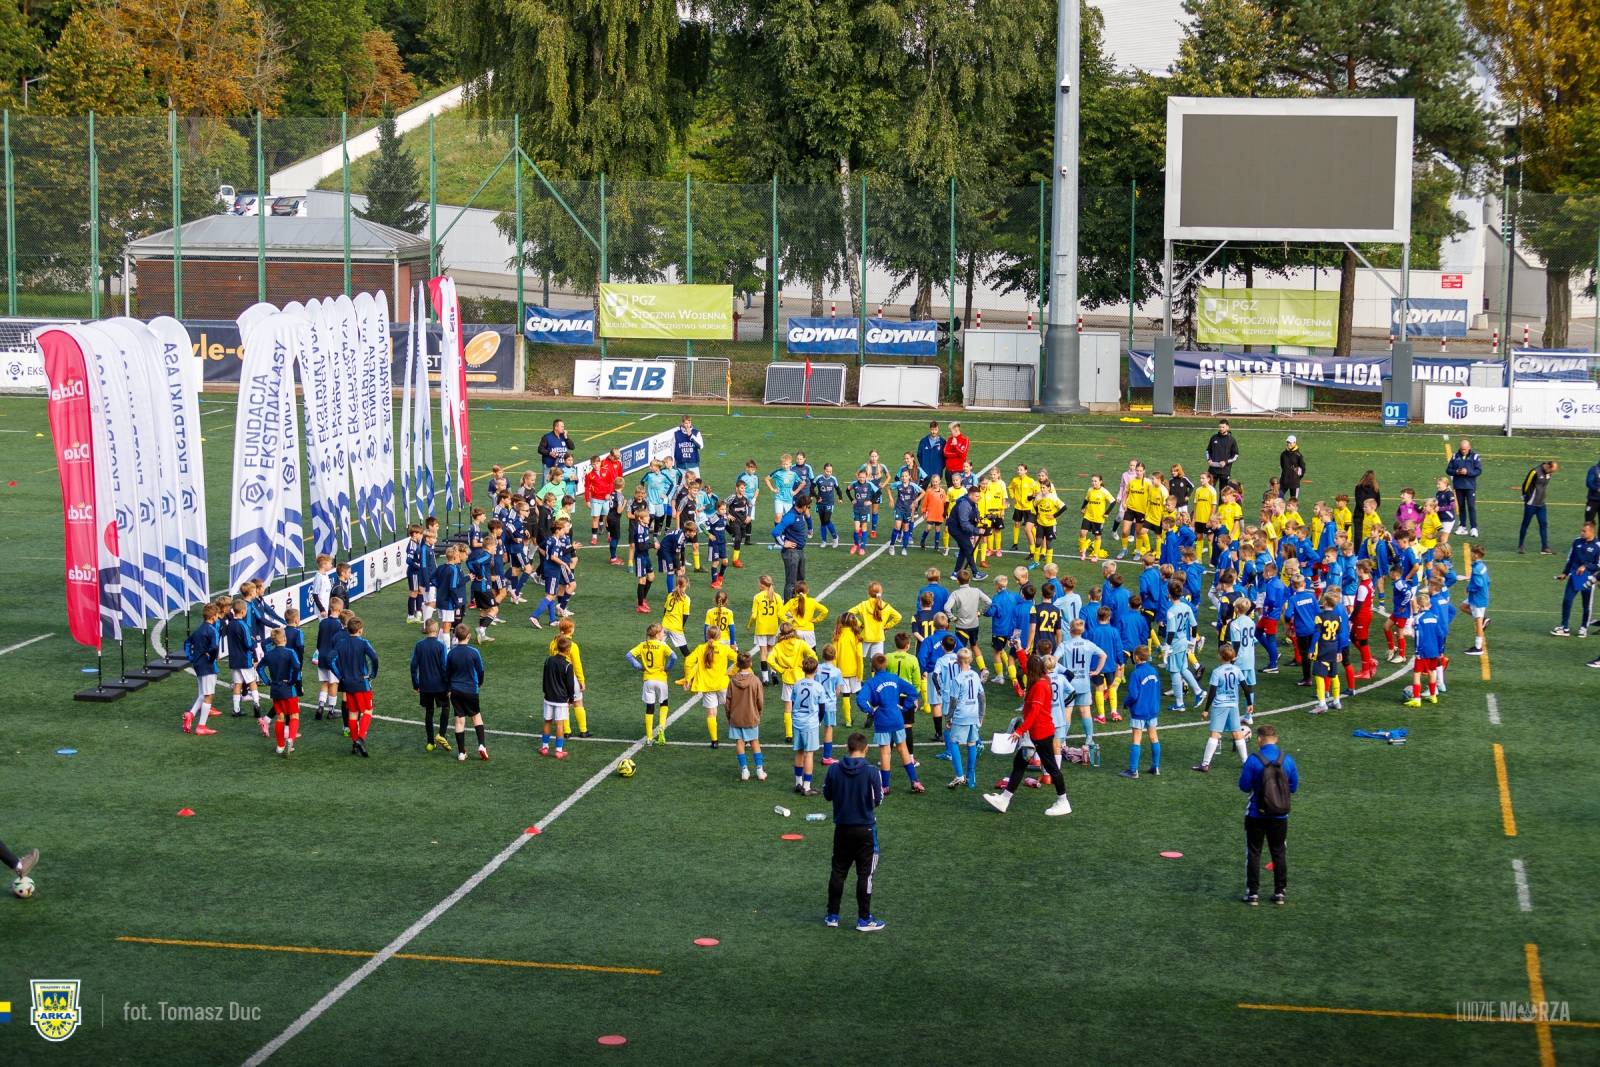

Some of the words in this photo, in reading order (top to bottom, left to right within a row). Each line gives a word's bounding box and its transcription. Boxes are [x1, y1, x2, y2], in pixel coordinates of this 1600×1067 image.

[631, 295, 656, 306] PGZ
[1232, 300, 1258, 311] PGZ
[631, 308, 677, 320] STOCZNIA
[678, 309, 727, 320] WOJENNA
[1231, 313, 1279, 326] STOCZNIA
[1281, 314, 1333, 328] WOJENNA
[1393, 308, 1466, 325] GDYNIA
[526, 316, 593, 333] GDYNIA
[605, 321, 638, 330] BUDUJEMY
[698, 322, 727, 331] MORSKIE
[788, 327, 858, 343] GDYNIA
[866, 327, 936, 344] GDYNIA
[1302, 330, 1332, 338] MORSKIE
[1513, 357, 1588, 374] GDYNIA
[608, 366, 667, 391] EIB
[1334, 363, 1382, 387] LIGA
[259, 339, 288, 470] EKSTRAKLASY
[1385, 405, 1400, 418] 01
[1474, 404, 1496, 413] Bank
[1498, 404, 1522, 414] Poski
[244, 373, 269, 468] FUNDACJA
[762, 599, 775, 616] 35
[1039, 609, 1058, 633] 23
[646, 650, 654, 668] 9
[1071, 647, 1086, 669] 14
[820, 671, 830, 686] 7
[1224, 671, 1236, 691] 10
[967, 678, 975, 700] 11
[800, 687, 811, 709] 2
